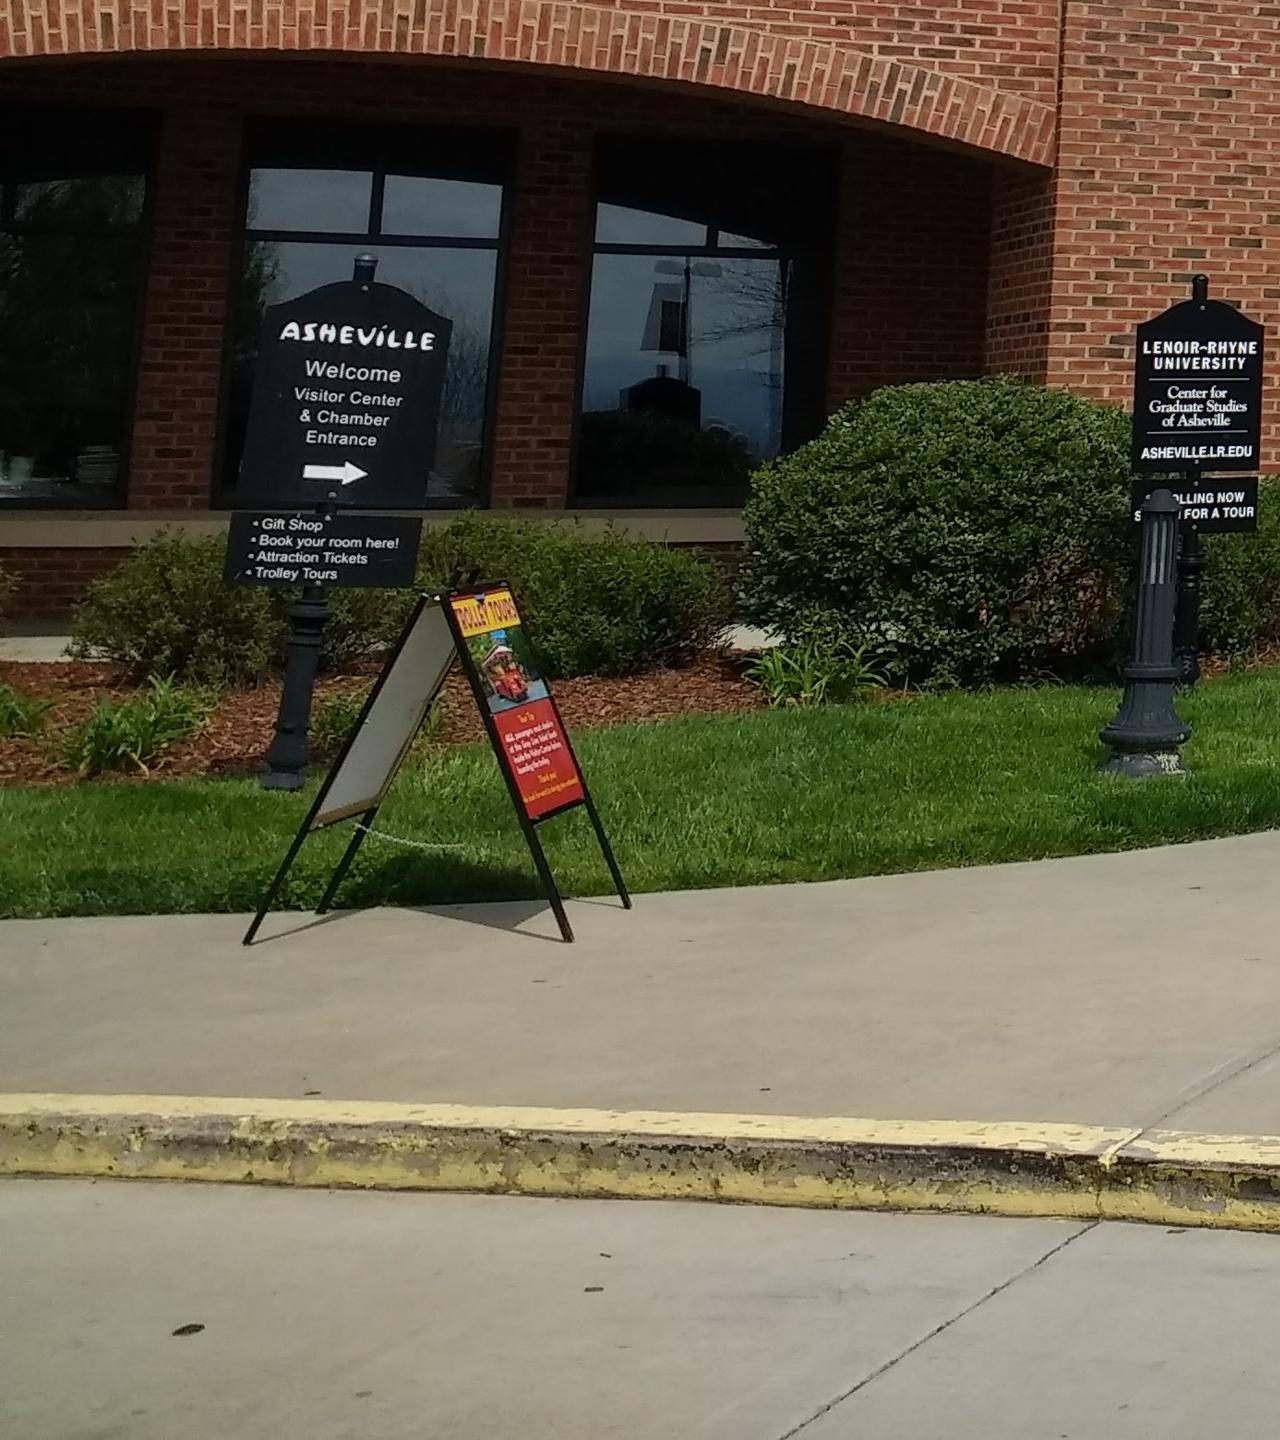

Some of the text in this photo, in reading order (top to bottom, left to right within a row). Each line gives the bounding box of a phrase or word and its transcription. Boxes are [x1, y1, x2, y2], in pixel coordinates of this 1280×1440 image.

[1153, 356, 1247, 370] UNIVERSITY
[305, 359, 402, 384] Welcome
[293, 386, 404, 407] Visitor Center
[1167, 385, 1228, 400] Center for
[1148, 399, 1248, 414] Graduate Studies
[299, 408, 391, 427] & Chamber
[1161, 412, 1231, 427] of Asheville
[305, 429, 378, 447] Entrance
[1140, 444, 1253, 460] ASHEVILLE.LR.EDU
[1216, 491, 1245, 504] NOW
[1183, 507, 1209, 520] FOR
[1210, 507, 1221, 519] A
[1223, 506, 1255, 519] TOUR
[261, 517, 324, 534] Gift Shop
[258, 534, 400, 550] Book your room here!
[256, 550, 369, 565] Attraction Tickets
[254, 565, 338, 582] Trolley Tours
